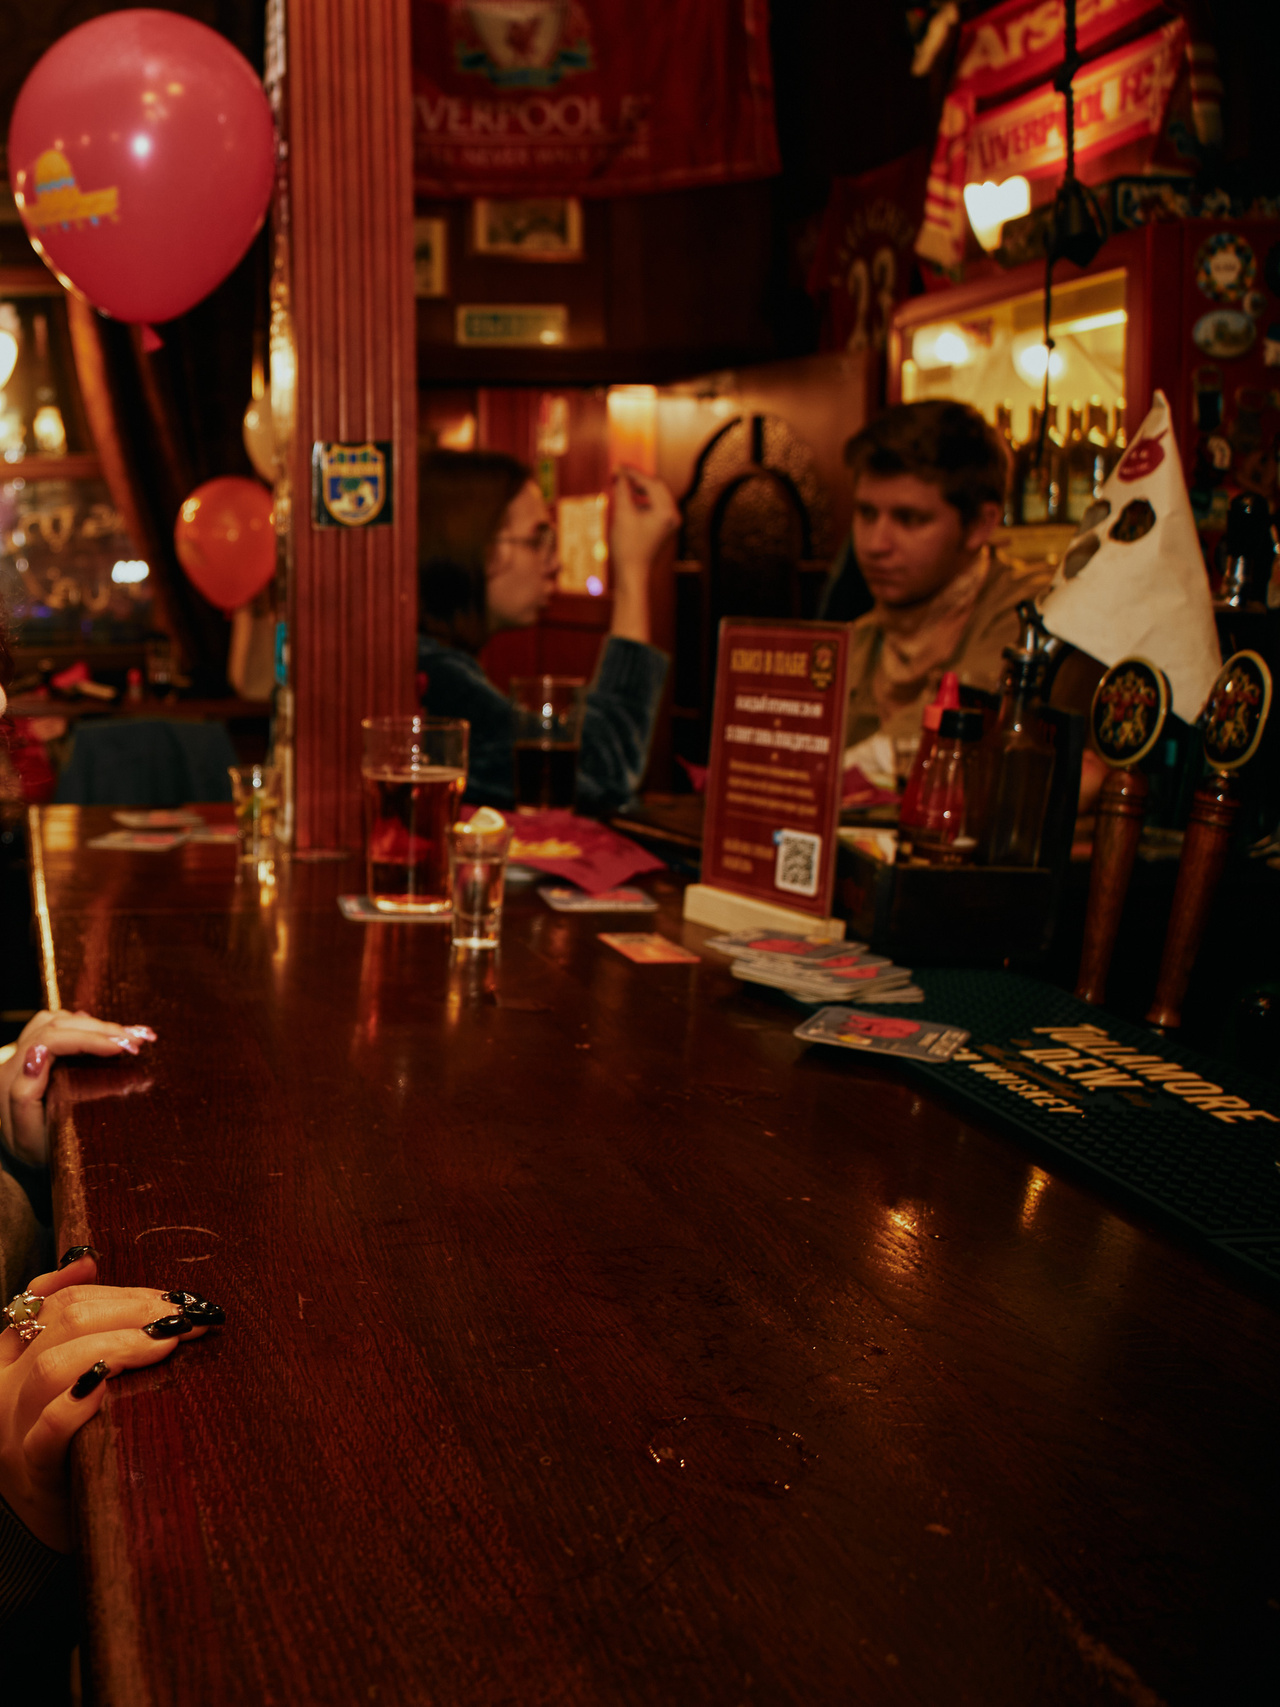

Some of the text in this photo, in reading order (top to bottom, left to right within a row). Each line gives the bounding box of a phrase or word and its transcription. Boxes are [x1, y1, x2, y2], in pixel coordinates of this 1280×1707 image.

[412, 95, 604, 135] VERPOOL
[968, 1061, 1084, 1115] WHISKEY
[1031, 1022, 1280, 1125] TULLAMORE
